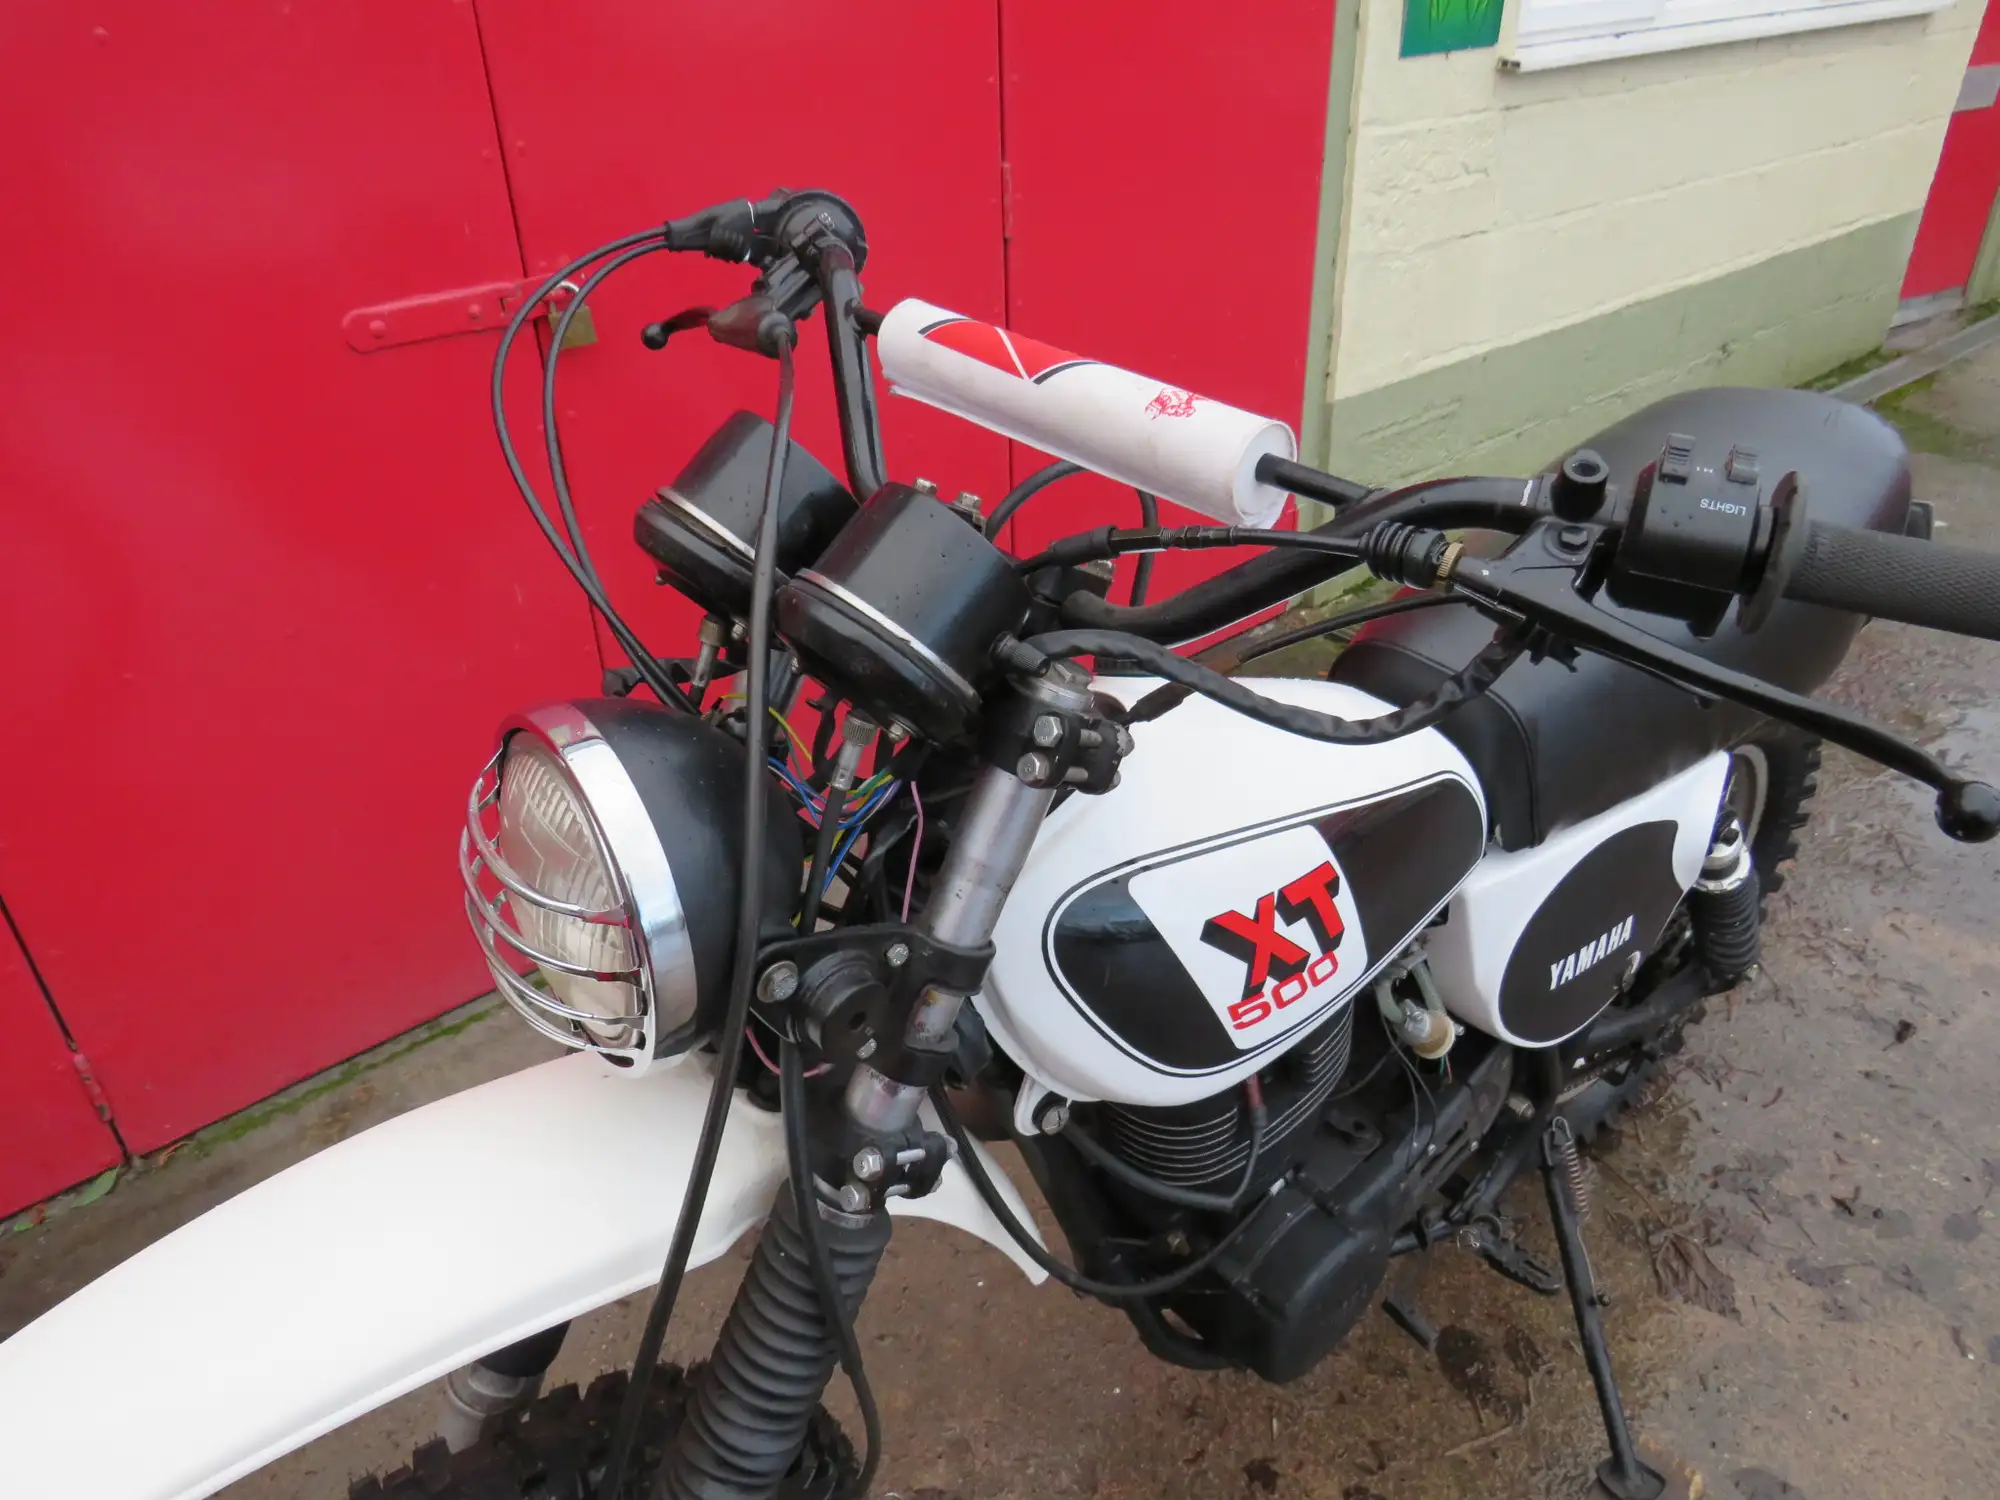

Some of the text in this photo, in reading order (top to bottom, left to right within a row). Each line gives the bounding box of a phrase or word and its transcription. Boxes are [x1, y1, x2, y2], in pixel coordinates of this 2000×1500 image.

[1699, 498, 1746, 516] LIGHTS
[1200, 860, 1345, 1001] XT
[1550, 914, 1634, 991] YAMAHA
[1227, 950, 1339, 1030] 500
